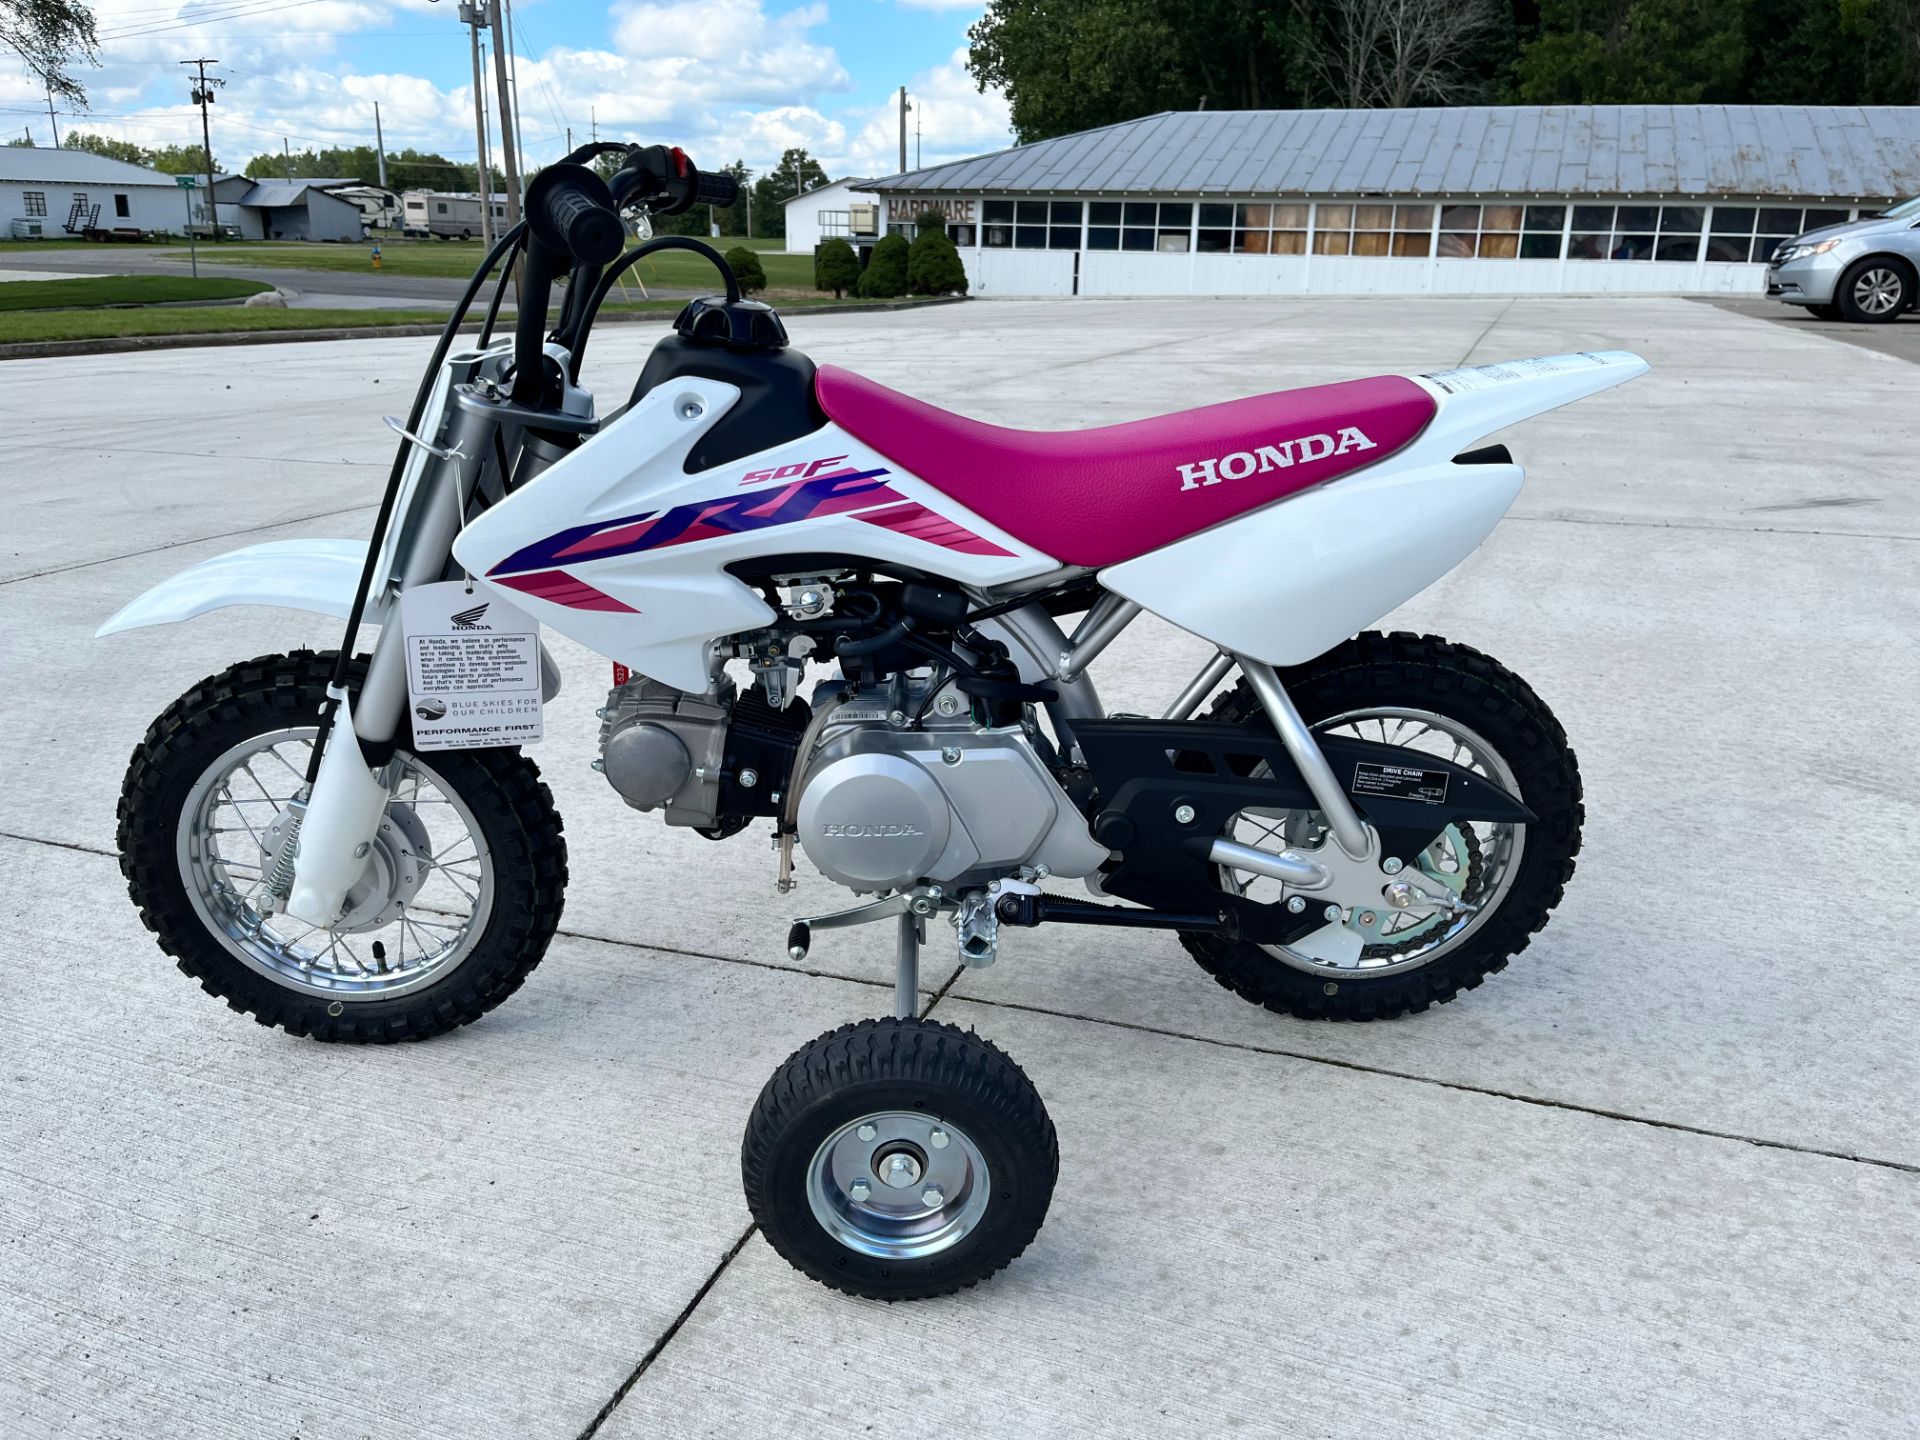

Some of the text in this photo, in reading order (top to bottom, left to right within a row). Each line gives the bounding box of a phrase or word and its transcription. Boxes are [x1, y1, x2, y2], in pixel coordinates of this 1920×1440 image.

[1176, 426, 1377, 491] HONDA
[738, 454, 849, 486] 50F
[483, 700, 514, 708] SKIES
[480, 706, 538, 715] CHILDREN
[416, 726, 502, 736] PERFORMANCE
[1383, 767, 1402, 775] DRIVE
[823, 824, 924, 837] HONDA
